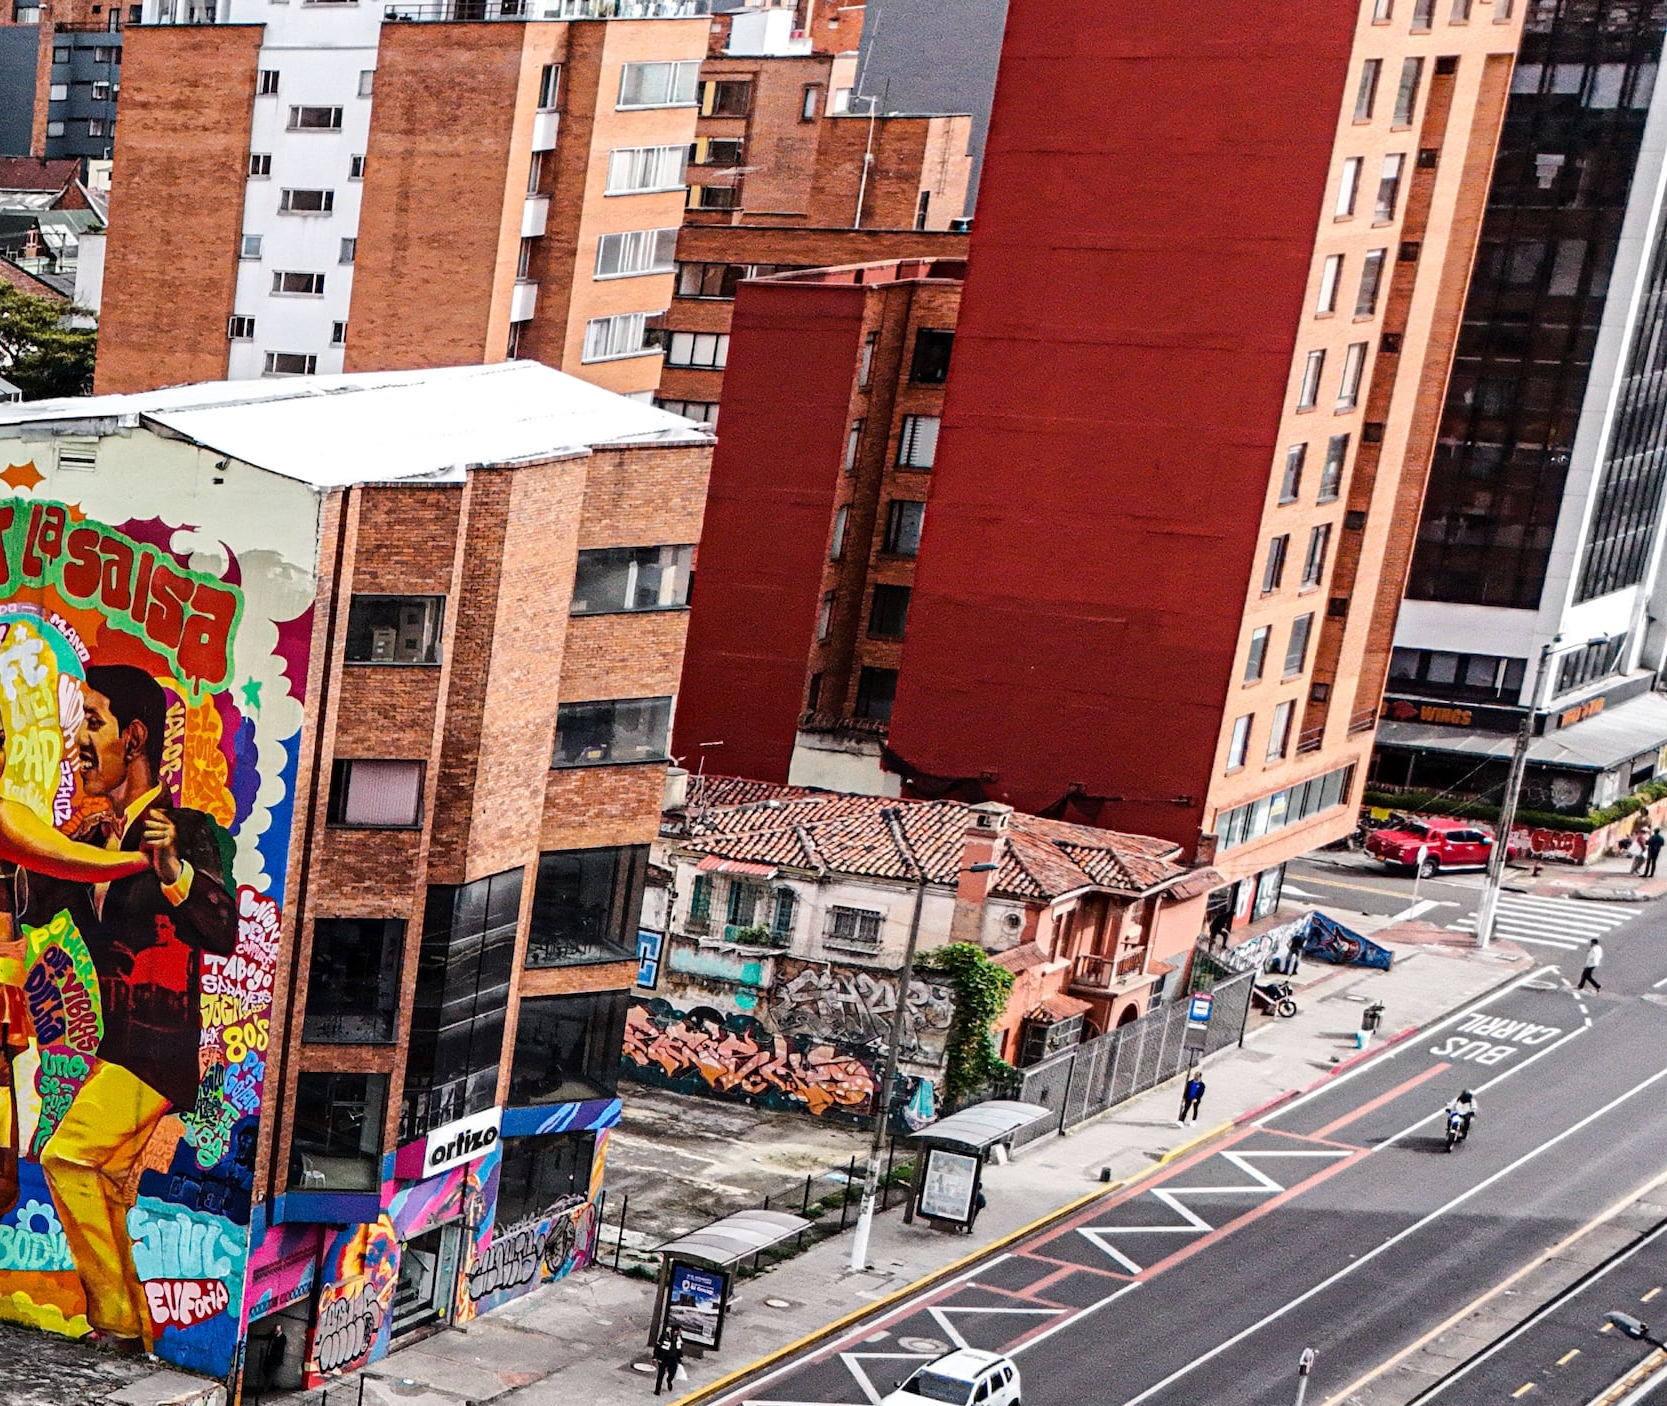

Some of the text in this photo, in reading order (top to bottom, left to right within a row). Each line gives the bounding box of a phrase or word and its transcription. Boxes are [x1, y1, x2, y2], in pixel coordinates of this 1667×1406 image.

[1457, 1013, 1562, 1044] CARRIL
[1430, 1036, 1517, 1065] BUS
[429, 1124, 498, 1166] ortizo
